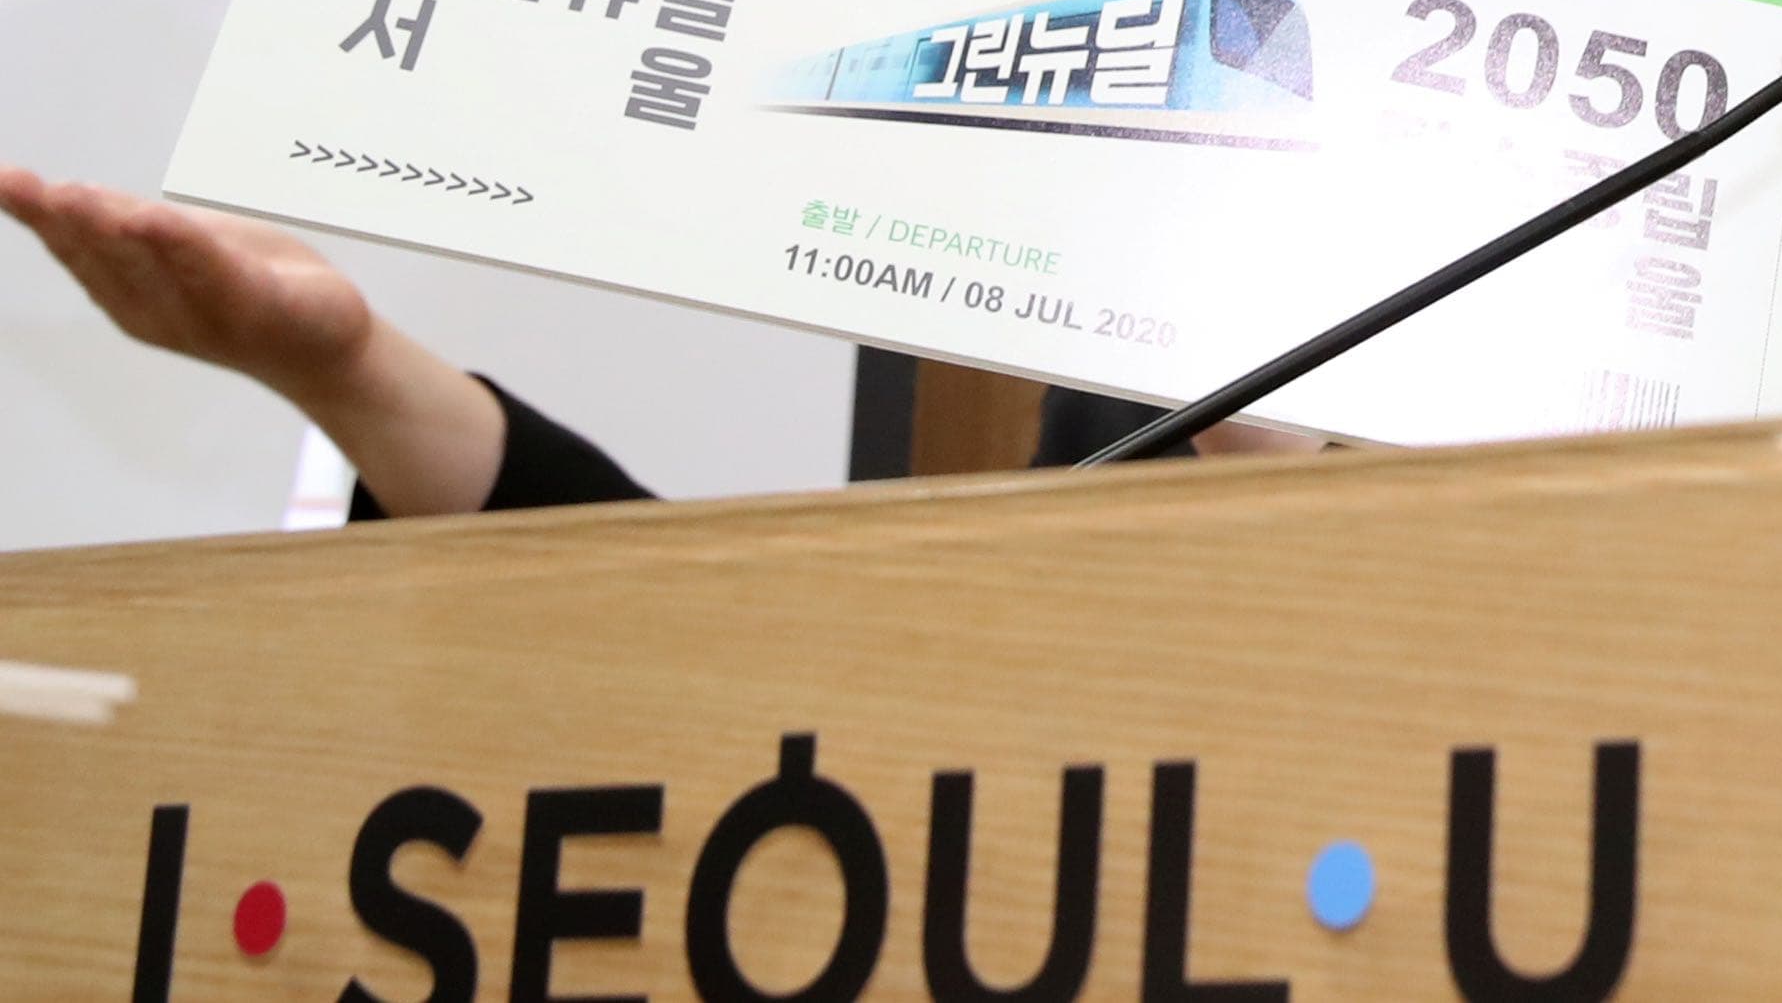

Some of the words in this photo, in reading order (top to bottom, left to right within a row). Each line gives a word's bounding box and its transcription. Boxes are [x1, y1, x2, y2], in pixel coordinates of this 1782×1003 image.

[801, 198, 862, 237] 출발
[888, 218, 1062, 276] DEPARTURE
[784, 243, 934, 299] 11:00AM
[963, 280, 1005, 313] 08
[1014, 293, 1083, 331] JUL
[1093, 308, 1178, 349] 2020
